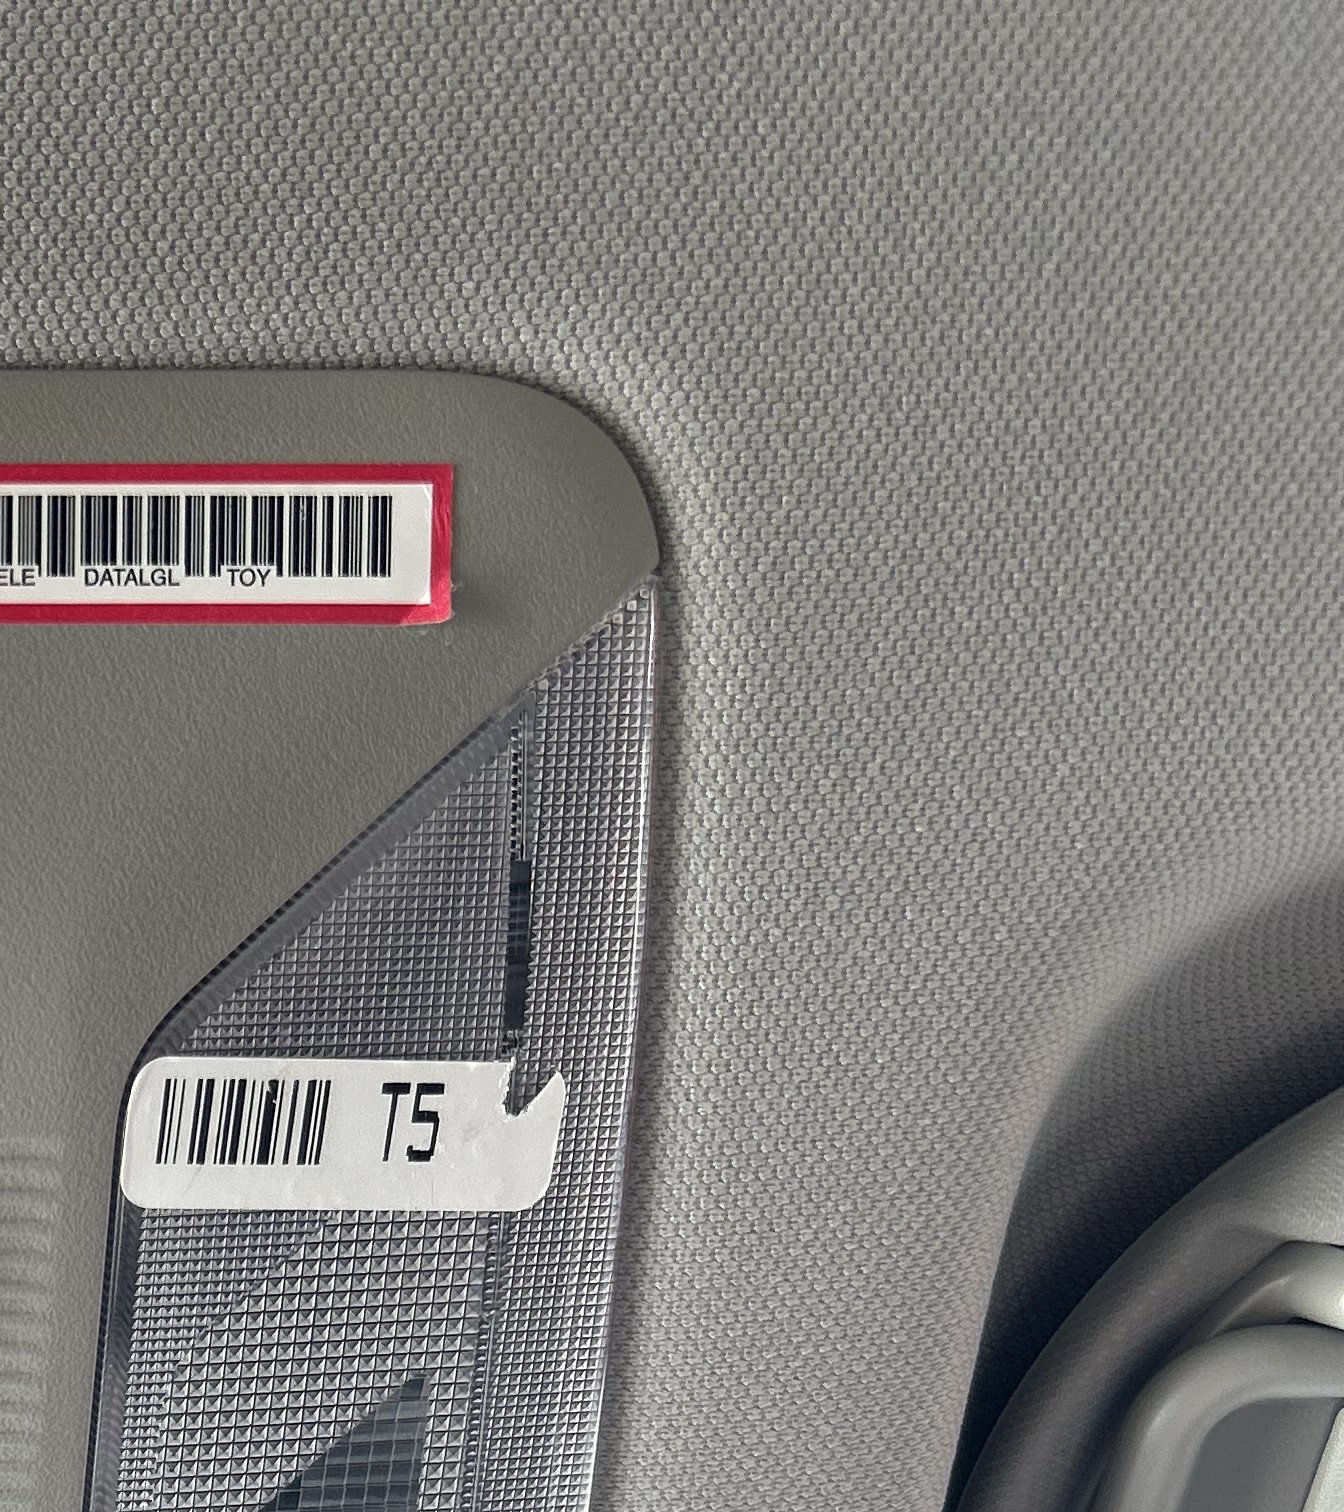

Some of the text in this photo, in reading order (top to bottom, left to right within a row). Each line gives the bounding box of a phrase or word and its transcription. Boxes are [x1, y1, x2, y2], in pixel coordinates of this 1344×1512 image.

[84, 568, 180, 587] DATALGL
[226, 568, 271, 587] TOY
[381, 1082, 446, 1163] T5
